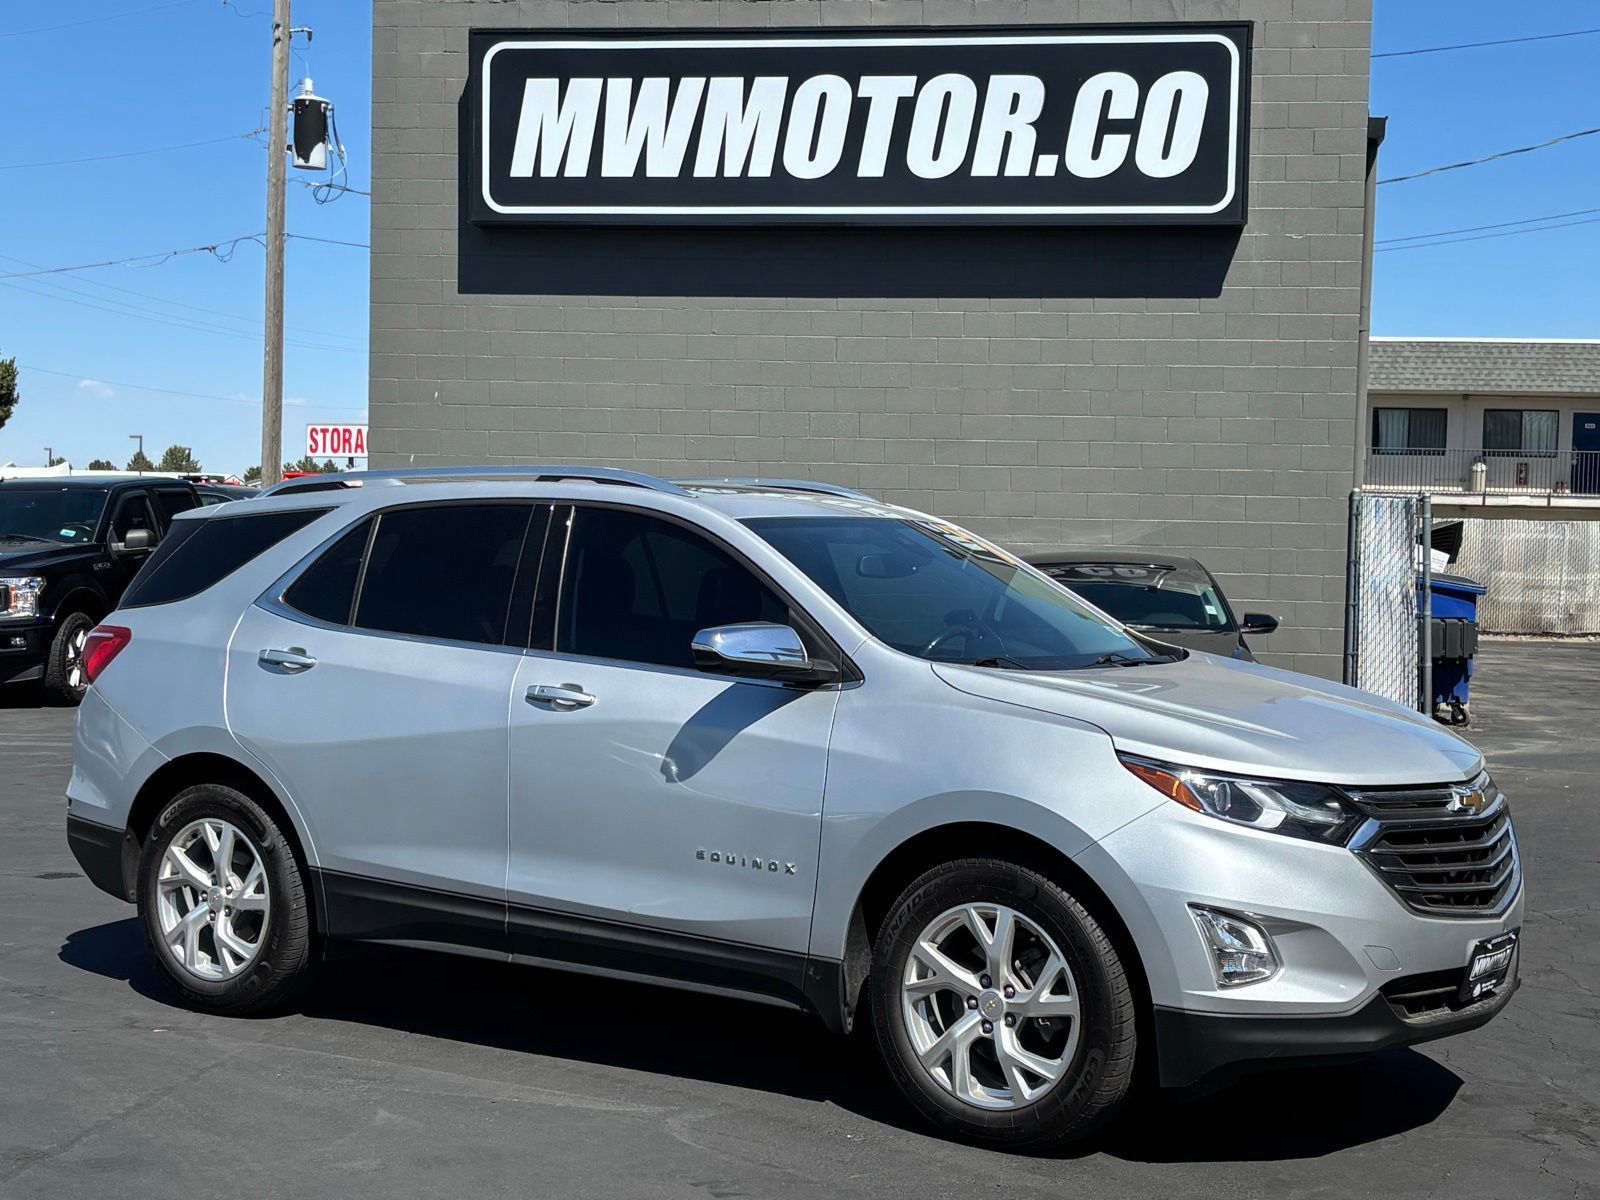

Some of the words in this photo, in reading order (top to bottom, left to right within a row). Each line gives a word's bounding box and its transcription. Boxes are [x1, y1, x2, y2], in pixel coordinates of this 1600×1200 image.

[509, 70, 1210, 180] MWMOTOR.CO
[309, 427, 369, 454] STORA
[695, 849, 797, 876] EQUINOX
